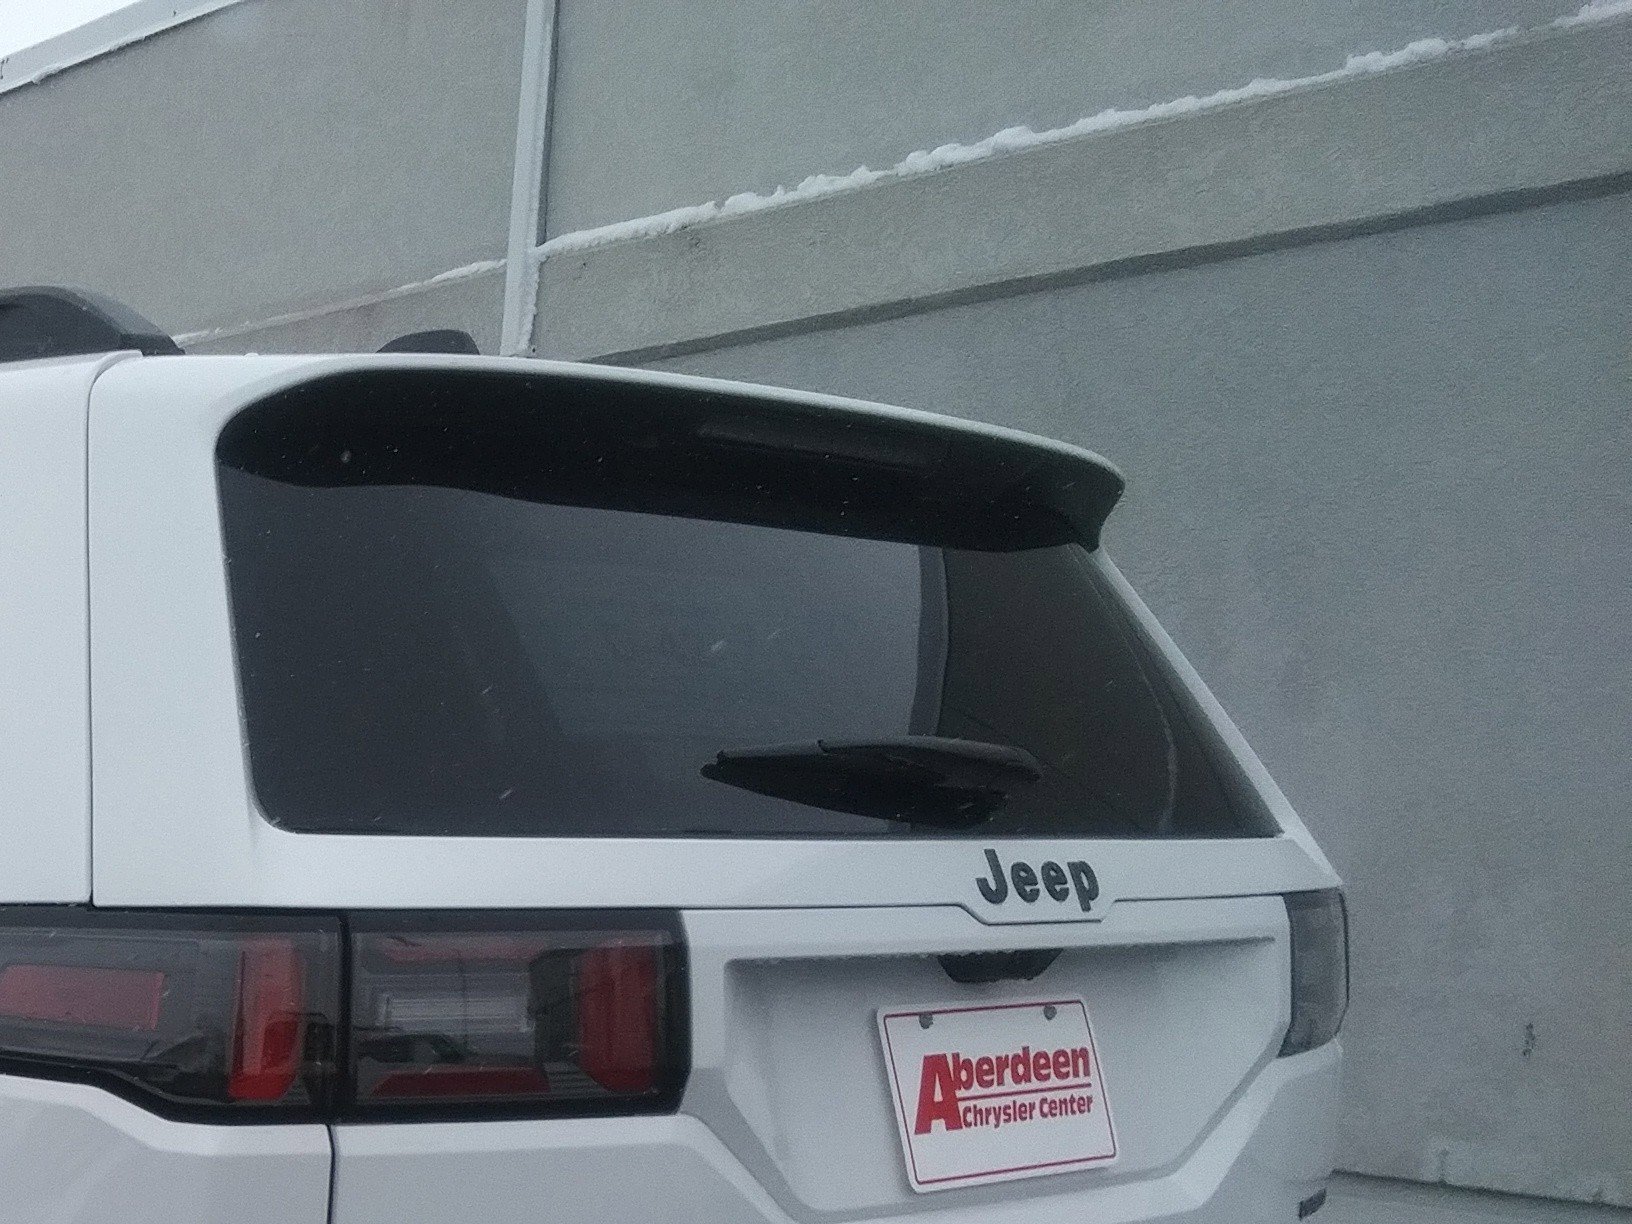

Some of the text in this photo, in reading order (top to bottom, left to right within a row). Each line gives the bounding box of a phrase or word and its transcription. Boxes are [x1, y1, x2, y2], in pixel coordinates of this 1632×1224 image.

[975, 848, 1100, 913] Jeep
[914, 1045, 1091, 1136] Aberdeen
[962, 1093, 1094, 1129] Chrysler Center
